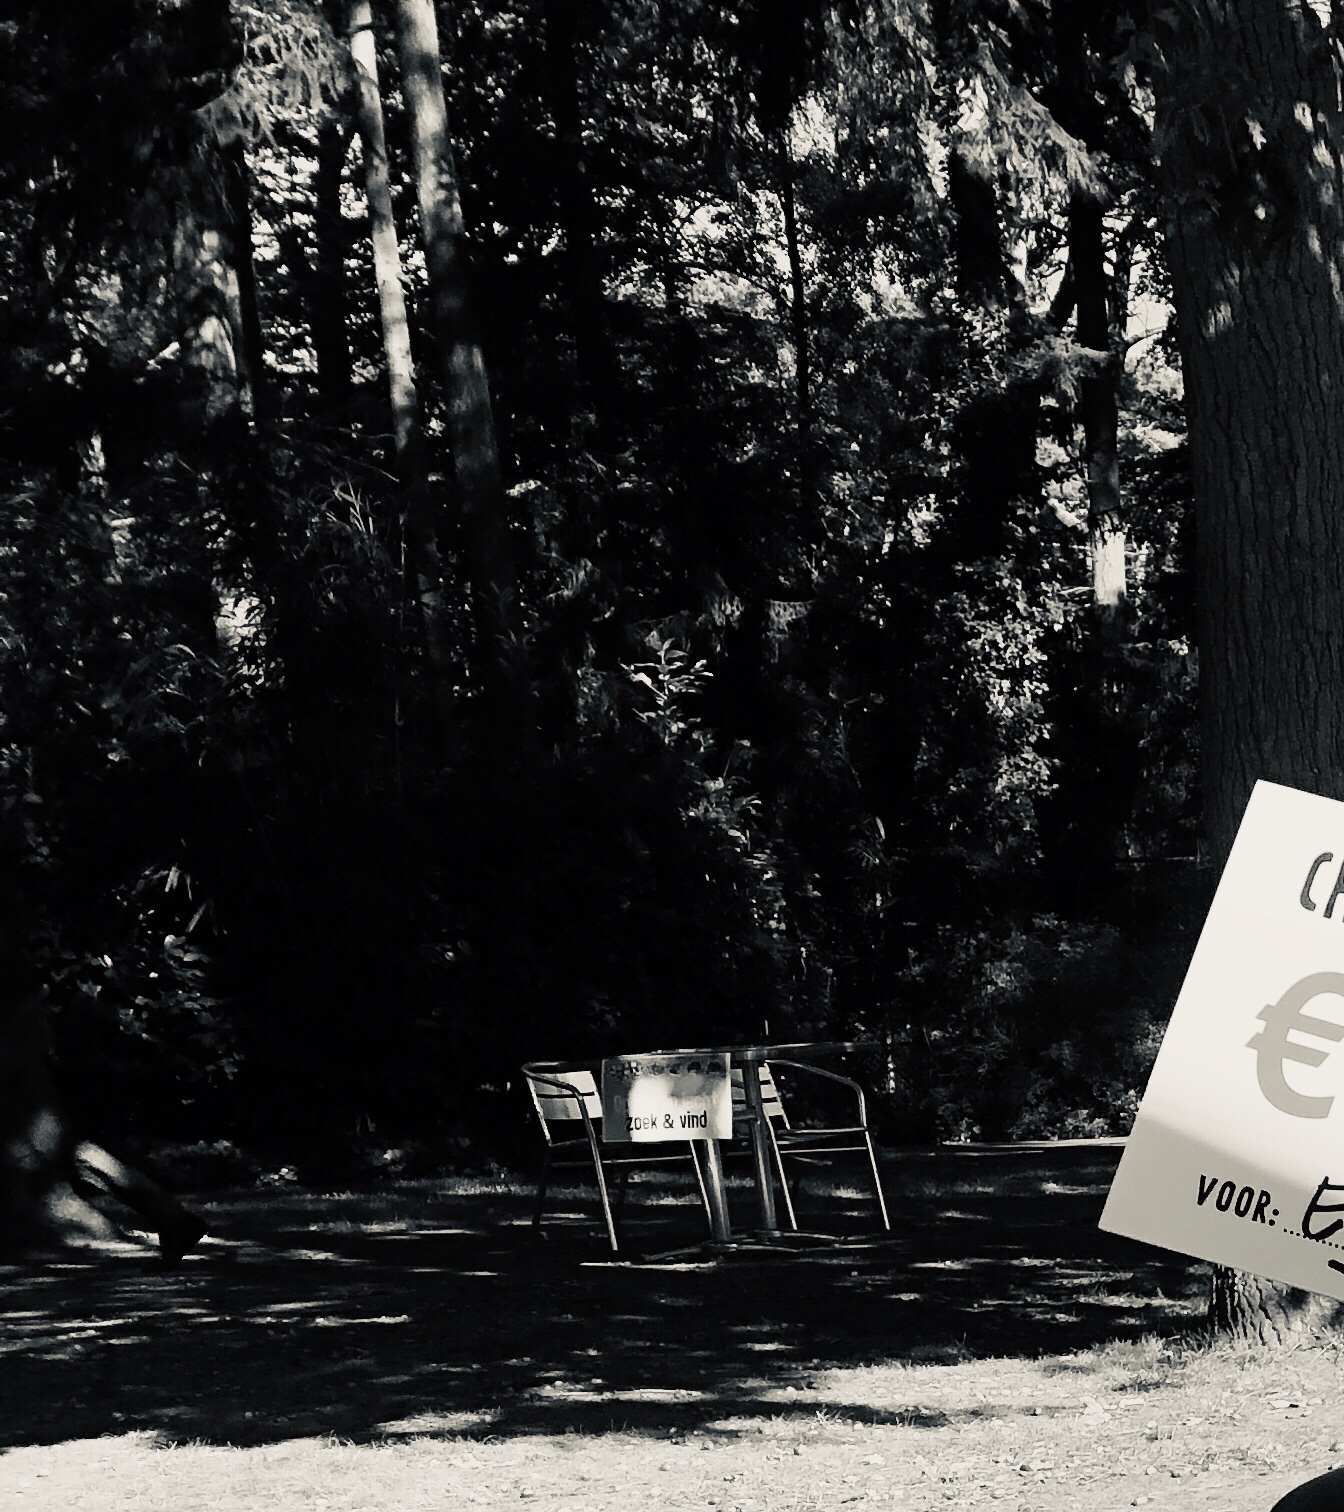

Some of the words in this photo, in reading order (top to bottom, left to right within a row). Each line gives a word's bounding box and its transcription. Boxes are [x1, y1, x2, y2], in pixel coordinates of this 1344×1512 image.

[626, 1113, 658, 1131] zoek
[663, 1114, 674, 1129] &
[680, 1110, 707, 1128] vind
[1196, 1173, 1281, 1228] VOOR:
